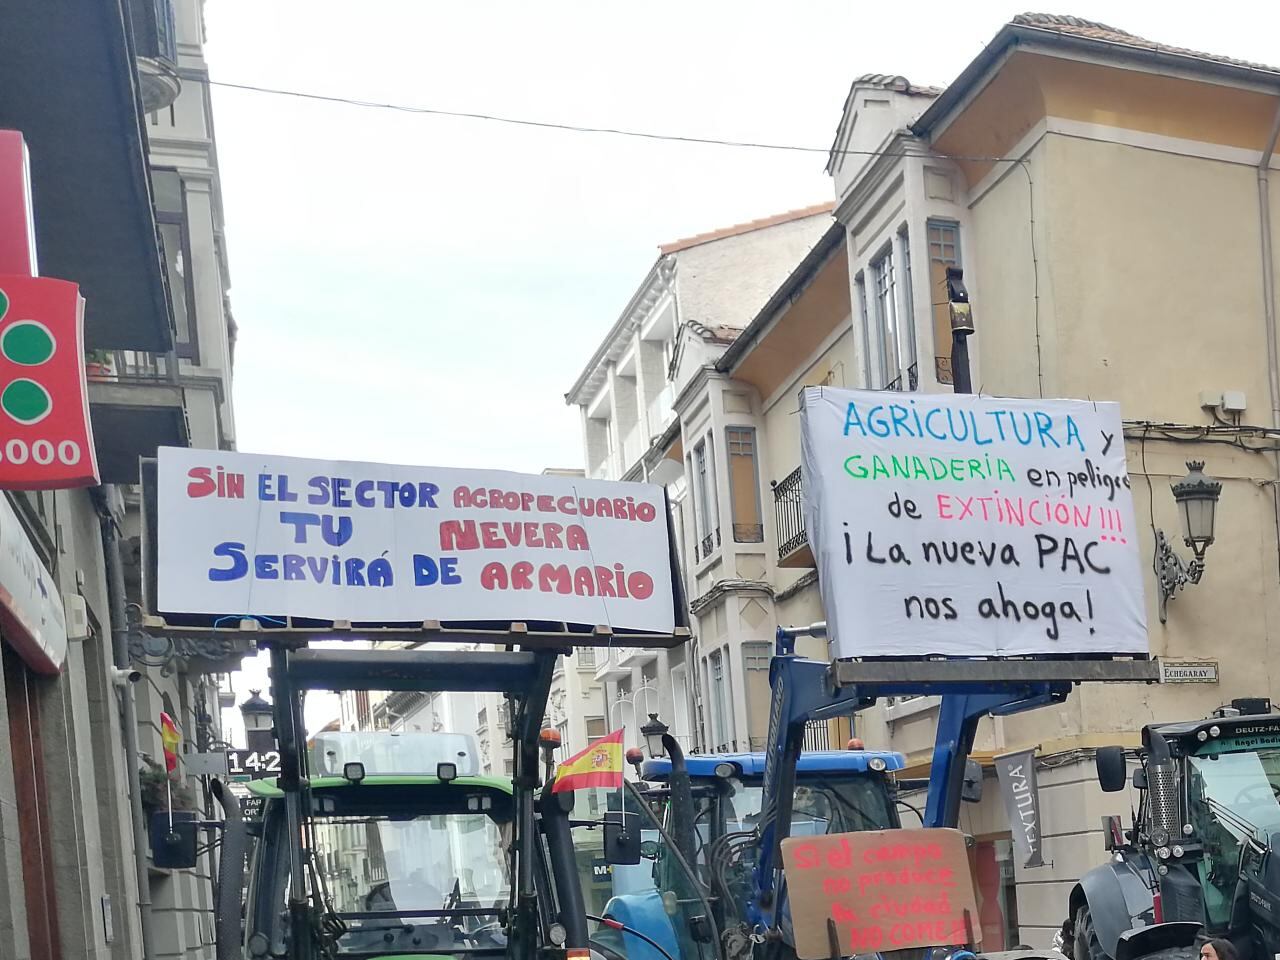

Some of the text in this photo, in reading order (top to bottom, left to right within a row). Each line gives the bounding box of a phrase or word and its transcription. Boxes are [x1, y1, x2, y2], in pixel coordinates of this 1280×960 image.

[0, 439, 81, 465] 000
[258, 473, 298, 502] EL
[308, 475, 440, 508] SECTOR
[1026, 466, 1061, 488] en
[888, 491, 922, 519] de
[280, 511, 590, 551] TU NEVERA
[922, 540, 1020, 568] nueva
[1035, 533, 1111, 575] PAC
[413, 553, 462, 587] DE
[904, 581, 1095, 640] nos ahoga!
[228, 751, 282, 773] 14:2
[863, 842, 943, 868] campo
[868, 891, 952, 921] ciudad
[851, 926, 883, 950] NO
